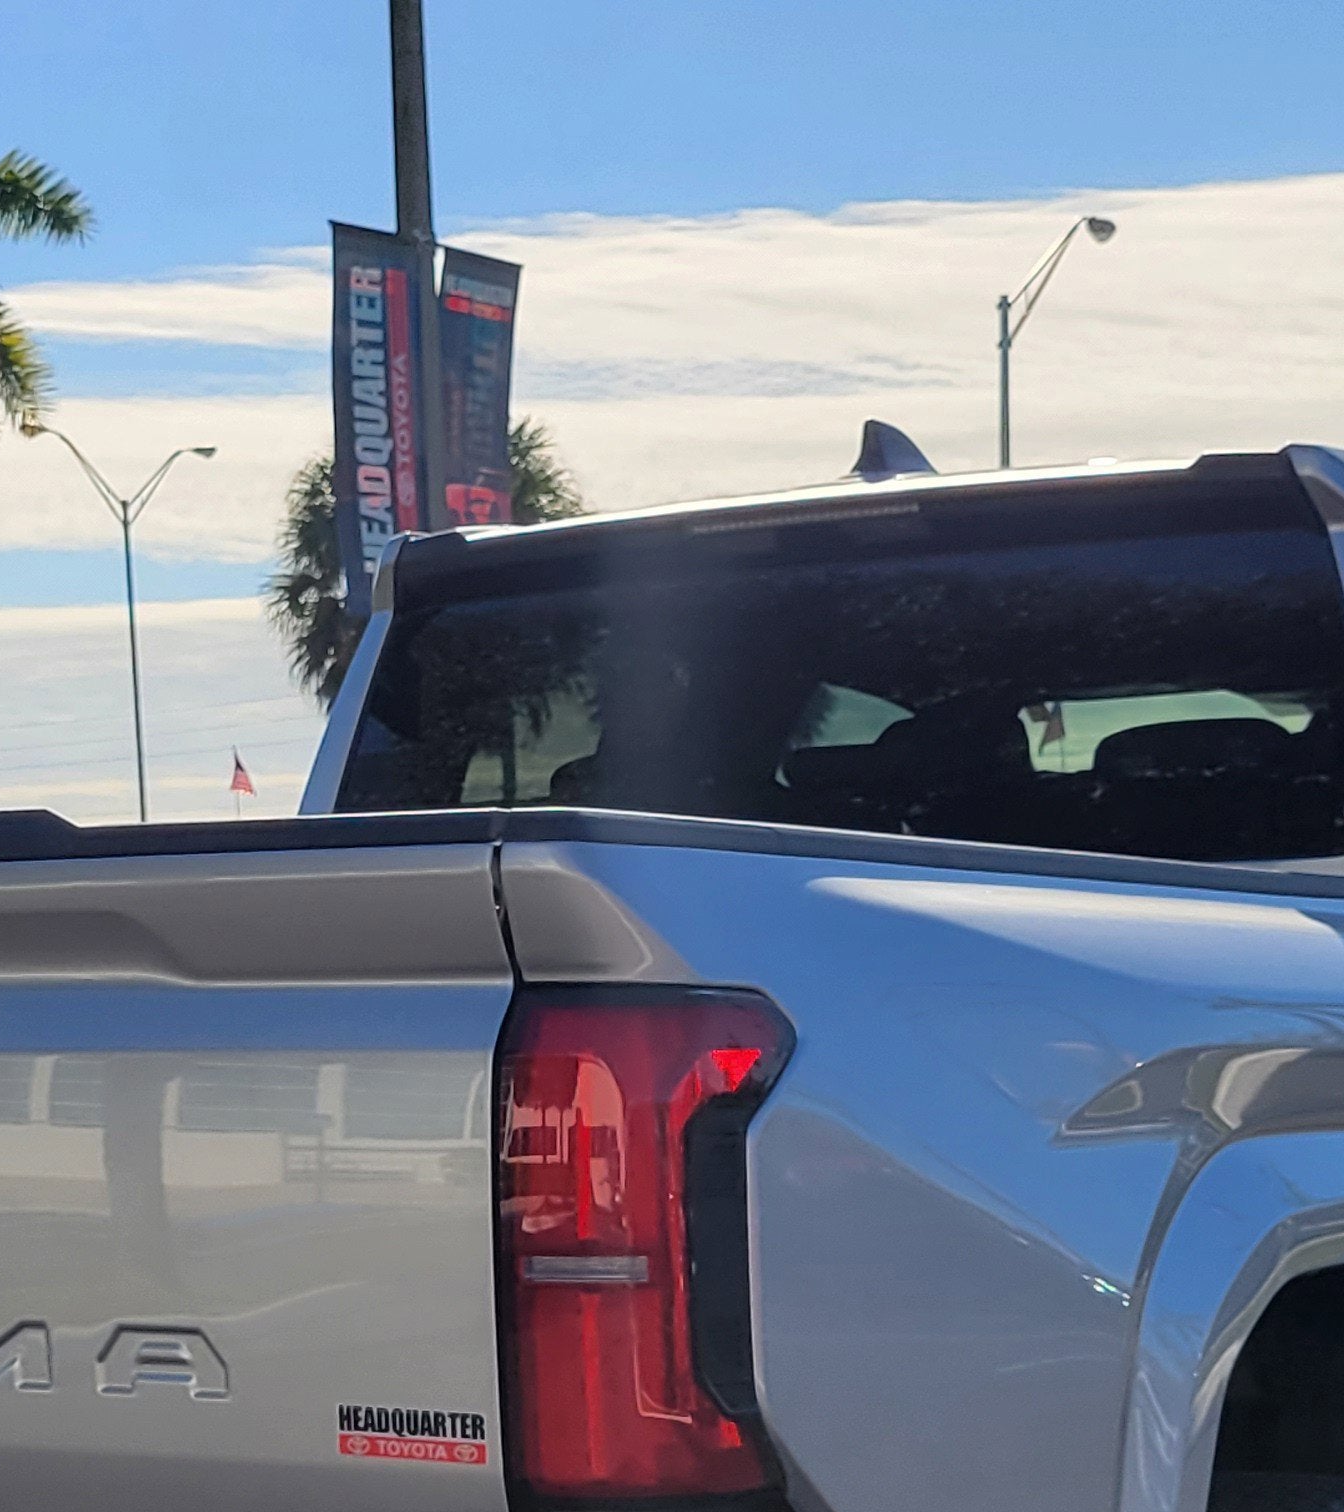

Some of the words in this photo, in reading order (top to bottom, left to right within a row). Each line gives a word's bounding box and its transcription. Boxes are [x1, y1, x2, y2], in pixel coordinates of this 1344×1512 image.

[392, 355, 412, 464] TOYOTA
[338, 1404, 486, 1441] HEADQUARTER
[375, 1439, 449, 1461] TOYOTA
